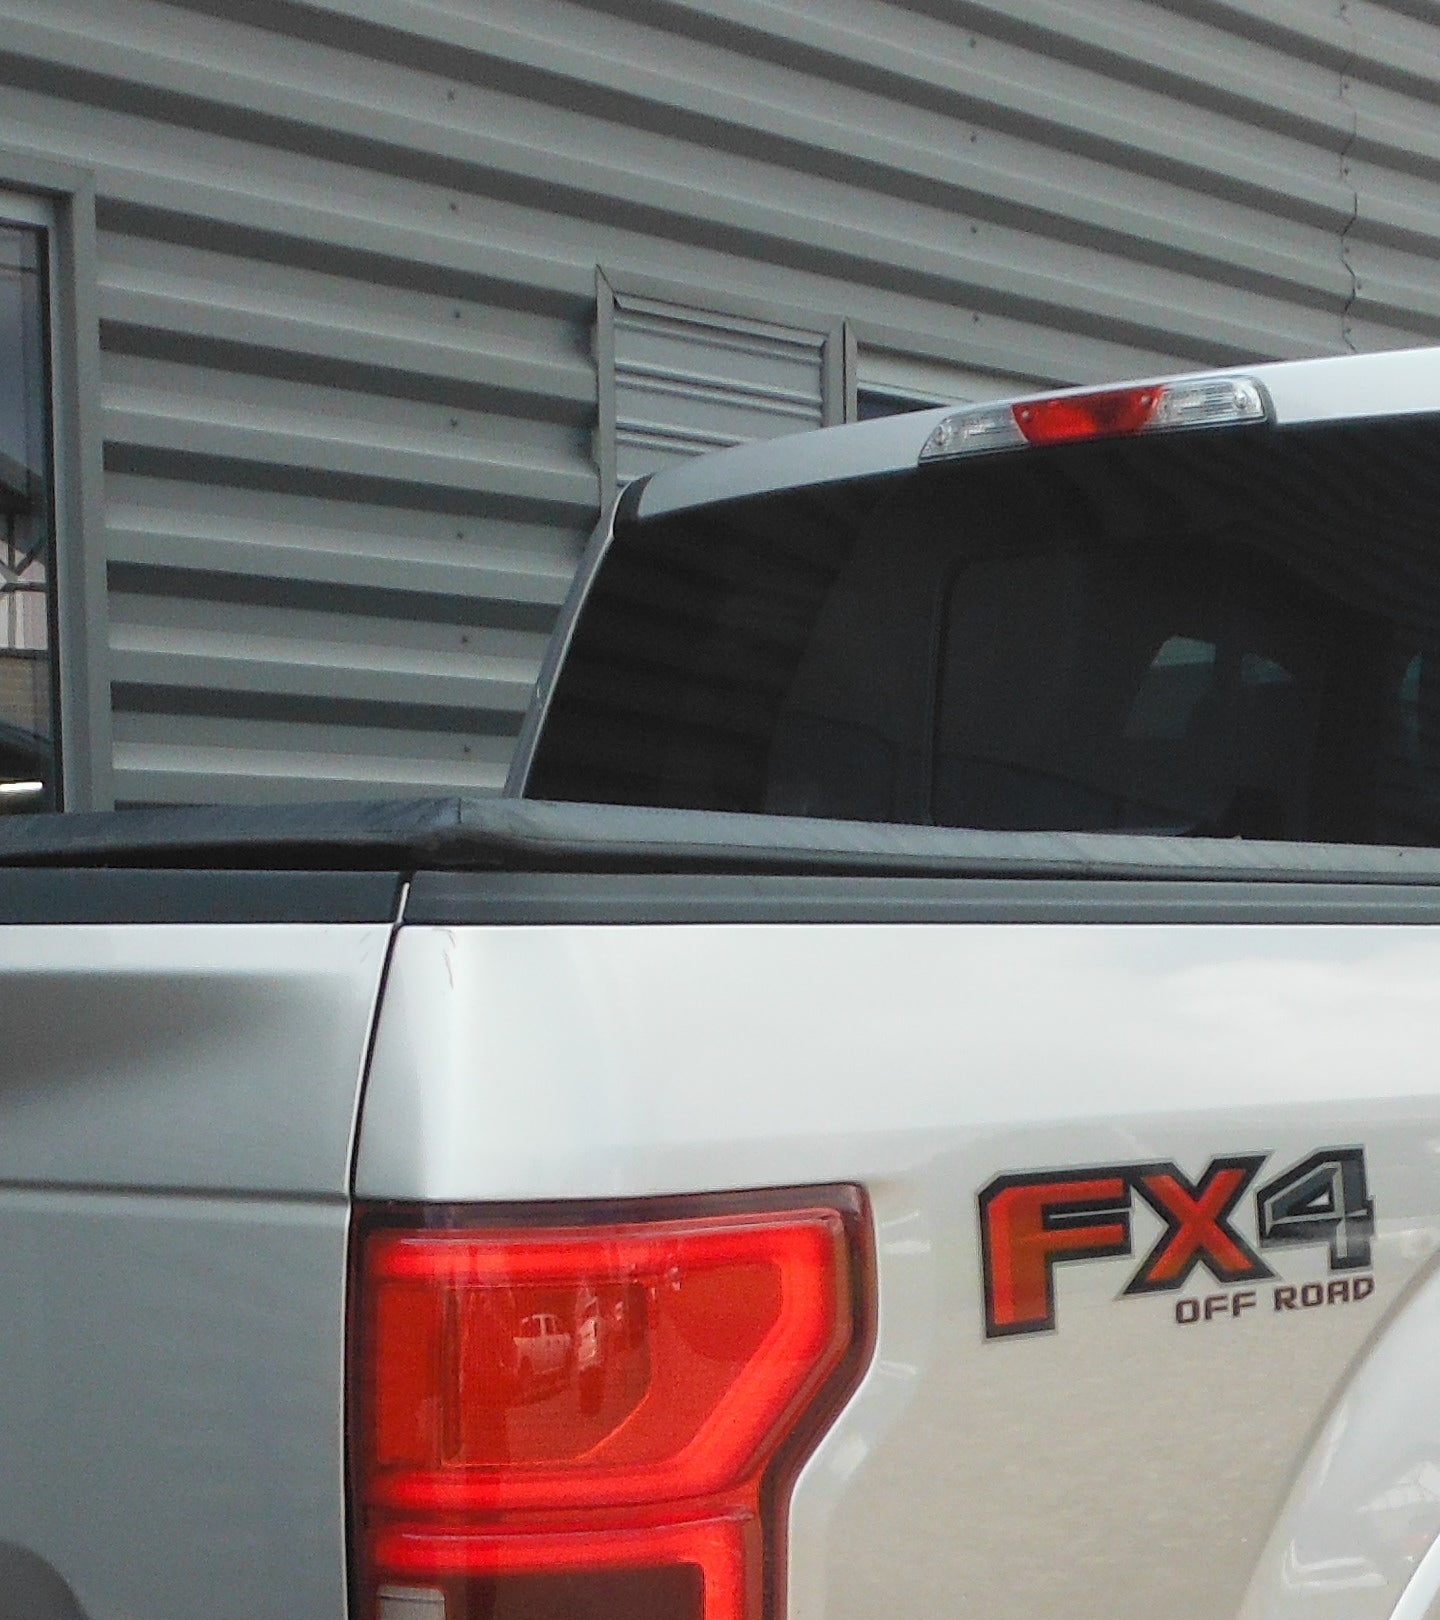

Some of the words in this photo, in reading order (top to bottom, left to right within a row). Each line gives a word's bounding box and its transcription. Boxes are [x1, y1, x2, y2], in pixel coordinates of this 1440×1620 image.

[978, 1146, 1375, 1341] FX4
[1175, 1290, 1257, 1325] OFF
[1274, 1276, 1375, 1311] ROAD
